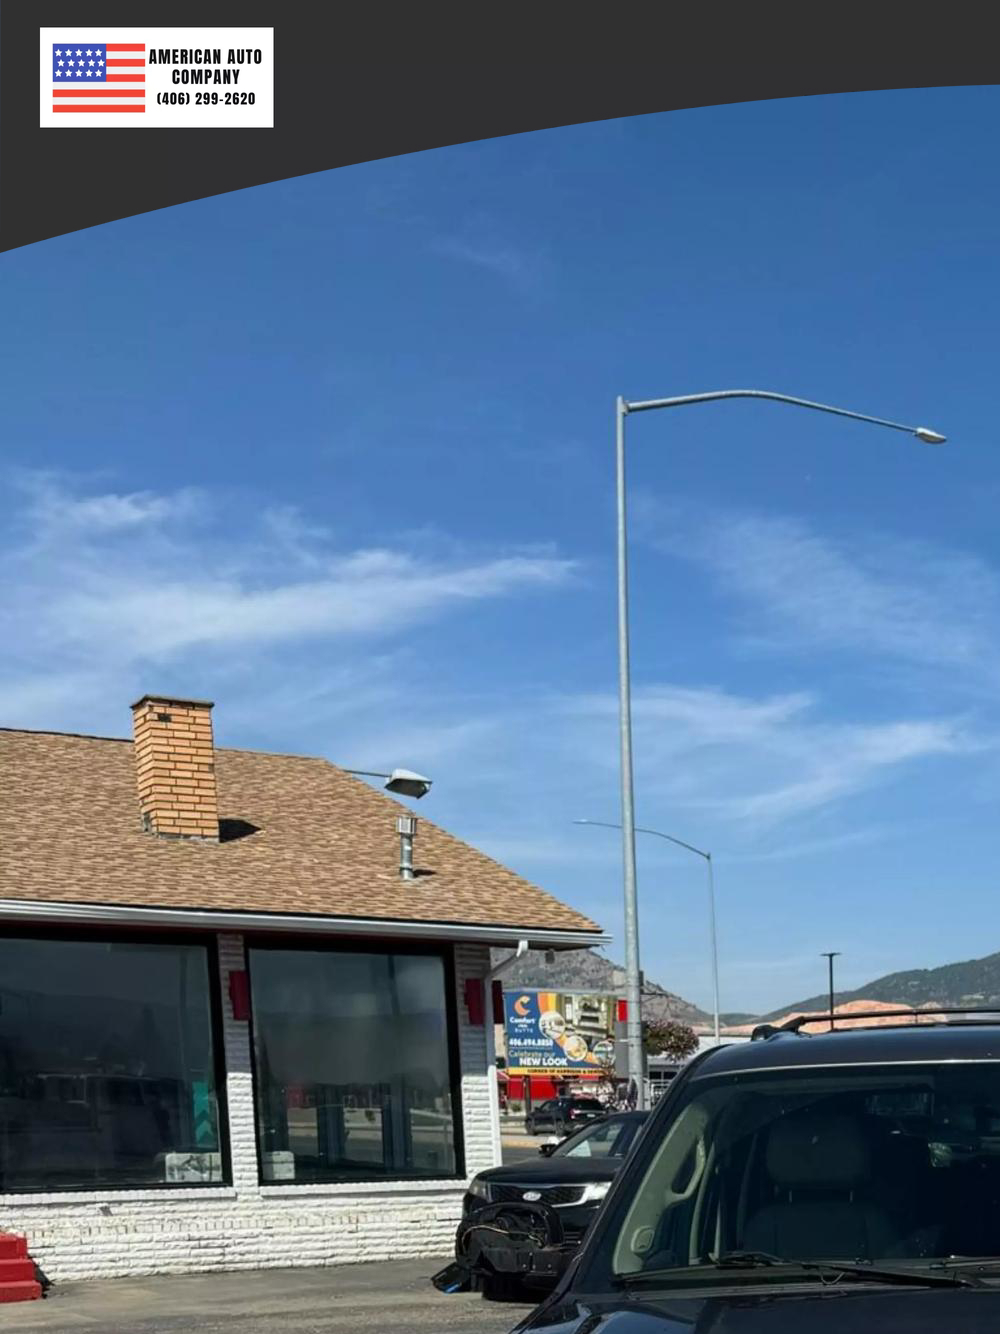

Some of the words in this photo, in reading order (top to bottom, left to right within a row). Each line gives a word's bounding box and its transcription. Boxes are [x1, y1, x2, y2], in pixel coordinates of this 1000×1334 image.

[509, 1016, 536, 1025] Comfort
[519, 1058, 541, 1066] NEW
[542, 1058, 568, 1066] LOOK
